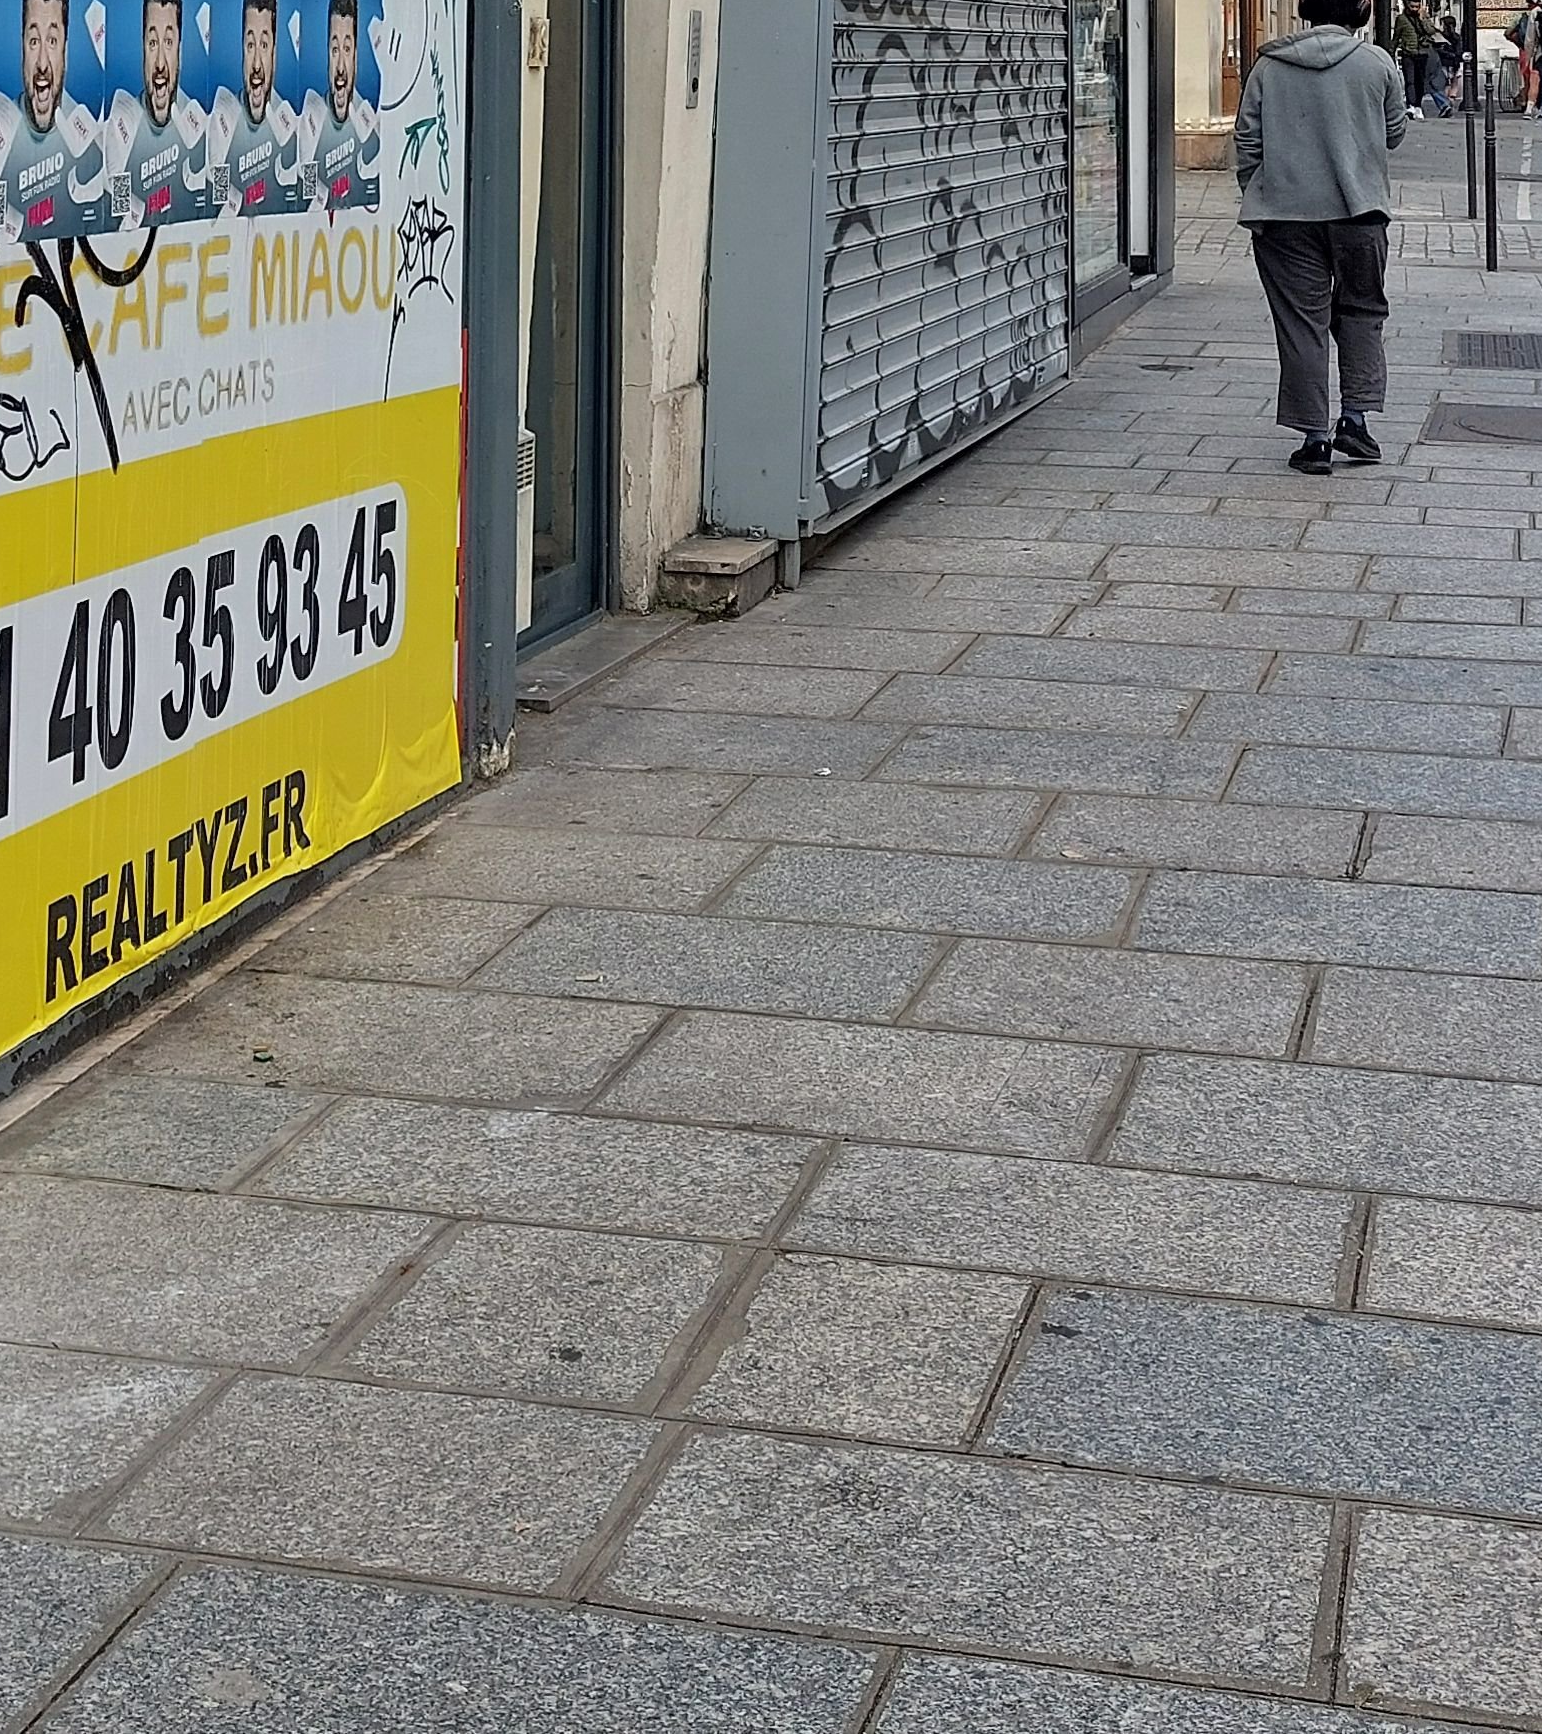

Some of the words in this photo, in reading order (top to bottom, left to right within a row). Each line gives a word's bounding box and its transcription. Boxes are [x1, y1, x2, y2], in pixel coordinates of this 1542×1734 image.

[18, 152, 65, 191] BRUNO
[140, 142, 180, 182] BRUNO
[238, 140, 272, 175] BRUNO
[325, 137, 355, 168] BRUNO
[249, 224, 397, 328] MIAOU
[121, 377, 195, 438] AVEC
[196, 360, 276, 417] CHATS
[47, 587, 137, 786] 40
[160, 549, 236, 742] 35
[256, 522, 321, 696] 93
[337, 499, 397, 657] 45
[44, 768, 311, 1003] REALTYZ.FR
